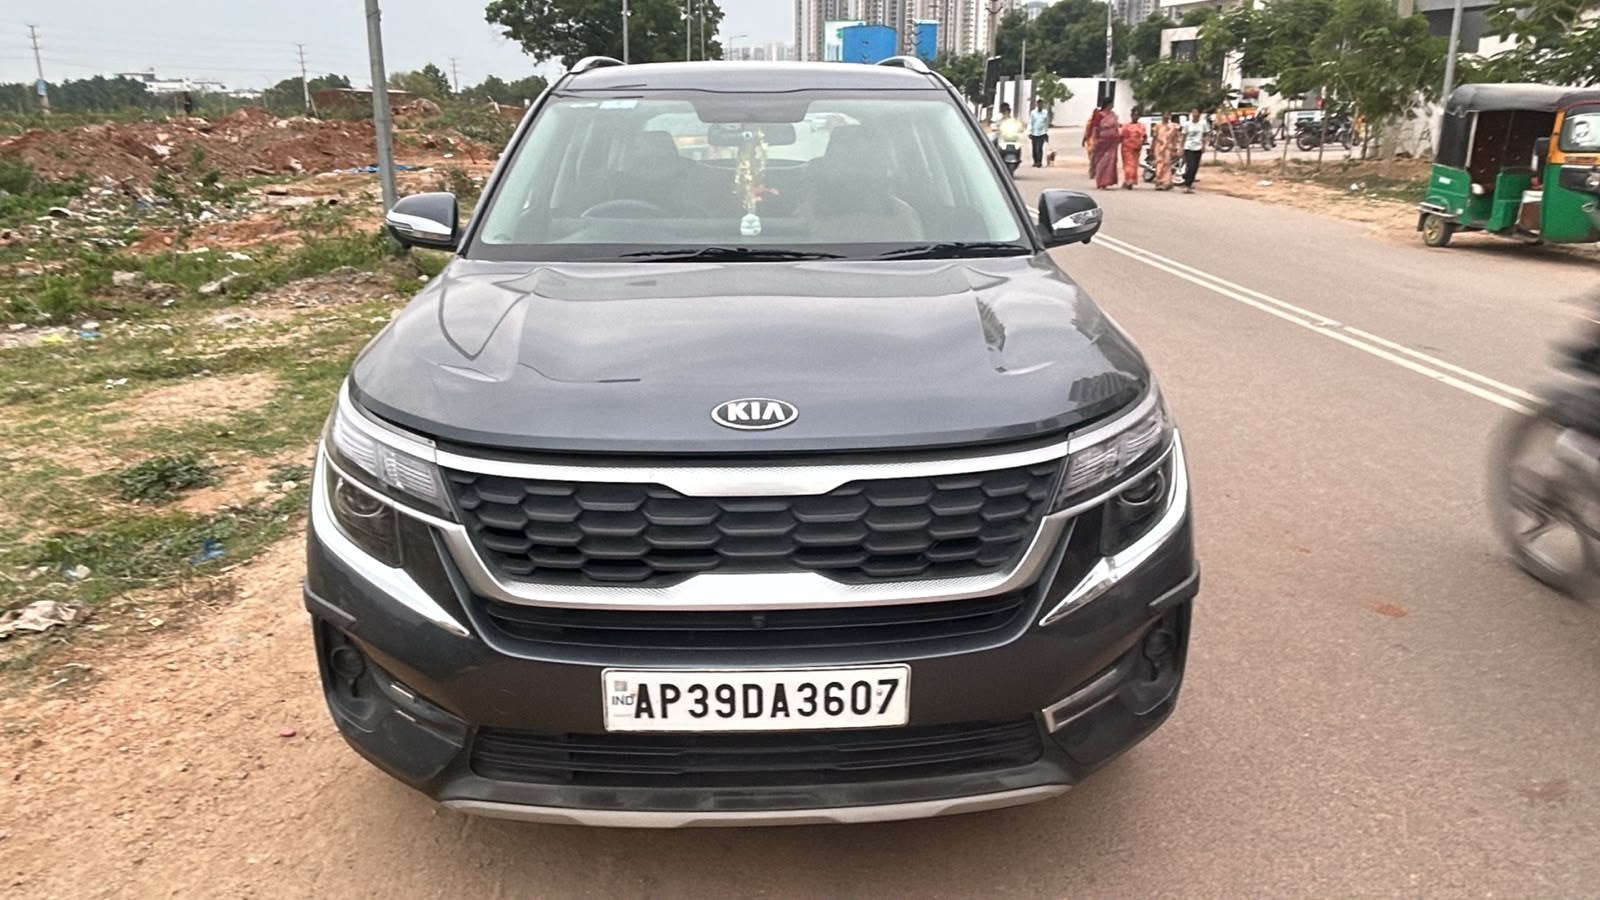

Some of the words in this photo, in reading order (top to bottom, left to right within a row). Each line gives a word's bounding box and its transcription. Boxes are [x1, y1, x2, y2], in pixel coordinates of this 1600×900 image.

[727, 402, 785, 421] KIA
[611, 695, 634, 706] IND
[634, 679, 899, 719] AP39DA3607
